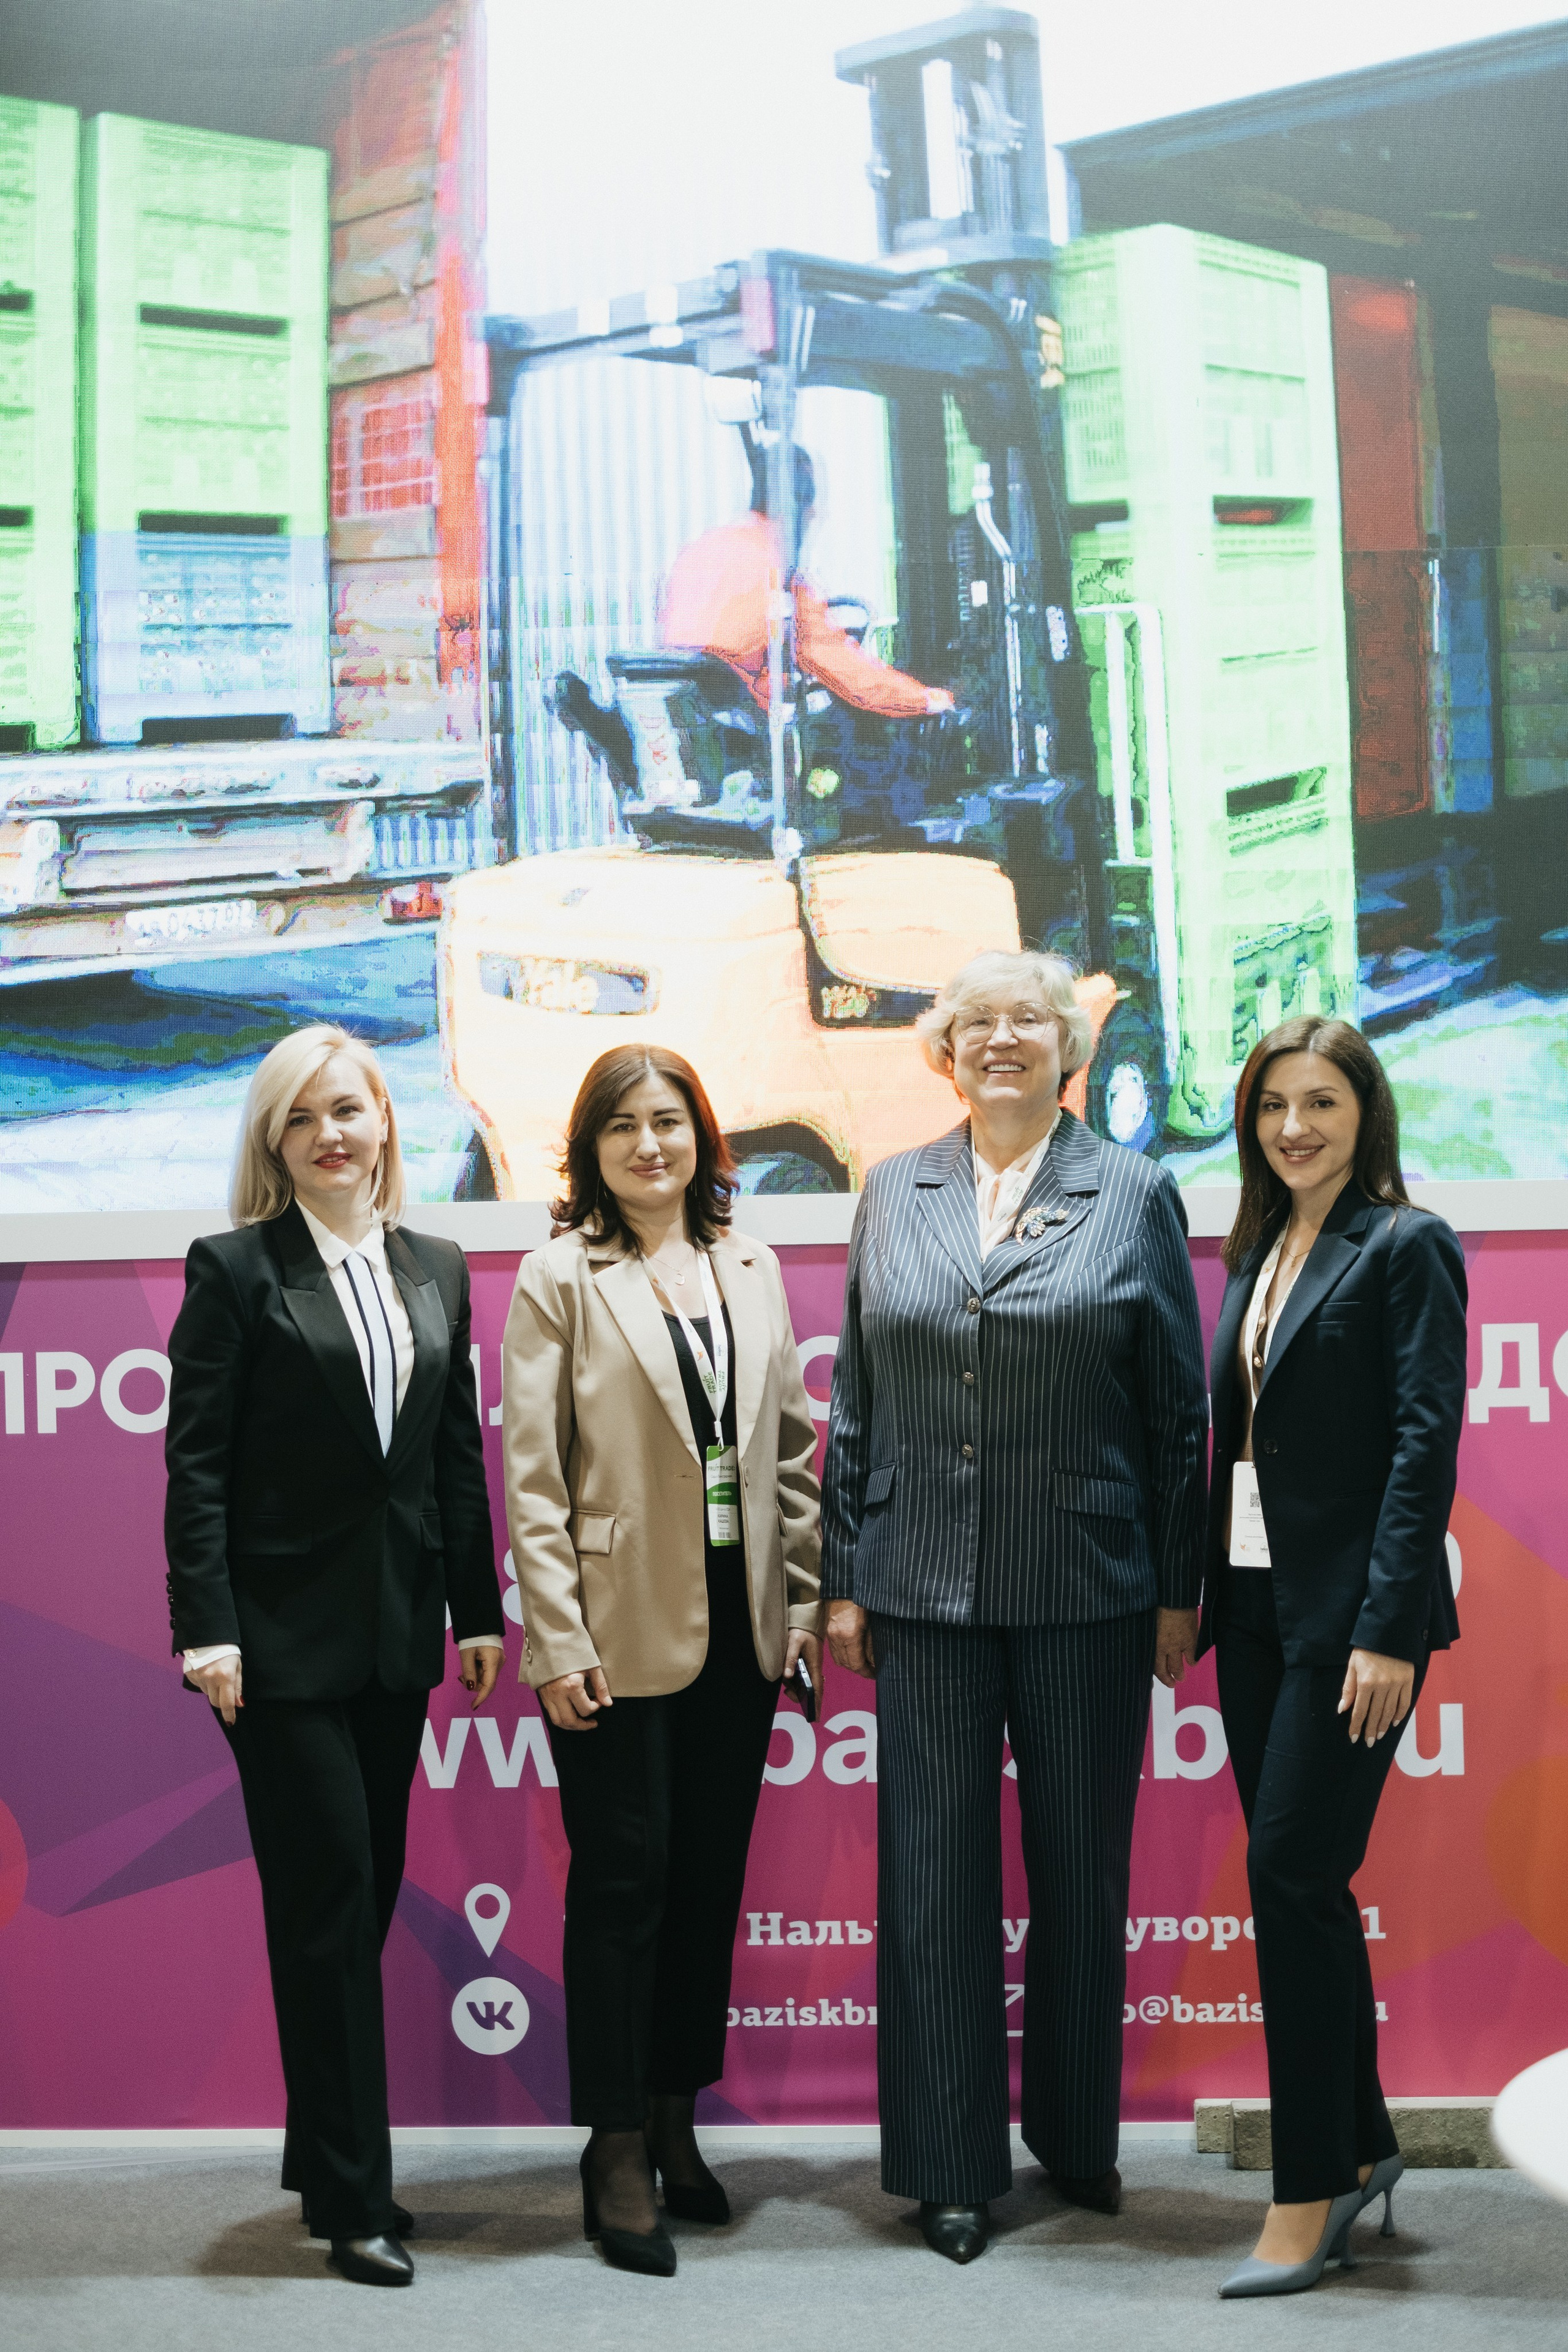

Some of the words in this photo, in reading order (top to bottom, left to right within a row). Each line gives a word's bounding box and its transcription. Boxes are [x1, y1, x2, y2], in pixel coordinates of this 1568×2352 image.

[702, 1374, 714, 1393] FRUIT
[707, 1371, 717, 1394] TRADE
[1468, 1322, 1568, 1423] Д
[746, 1912, 878, 1946] Наль
